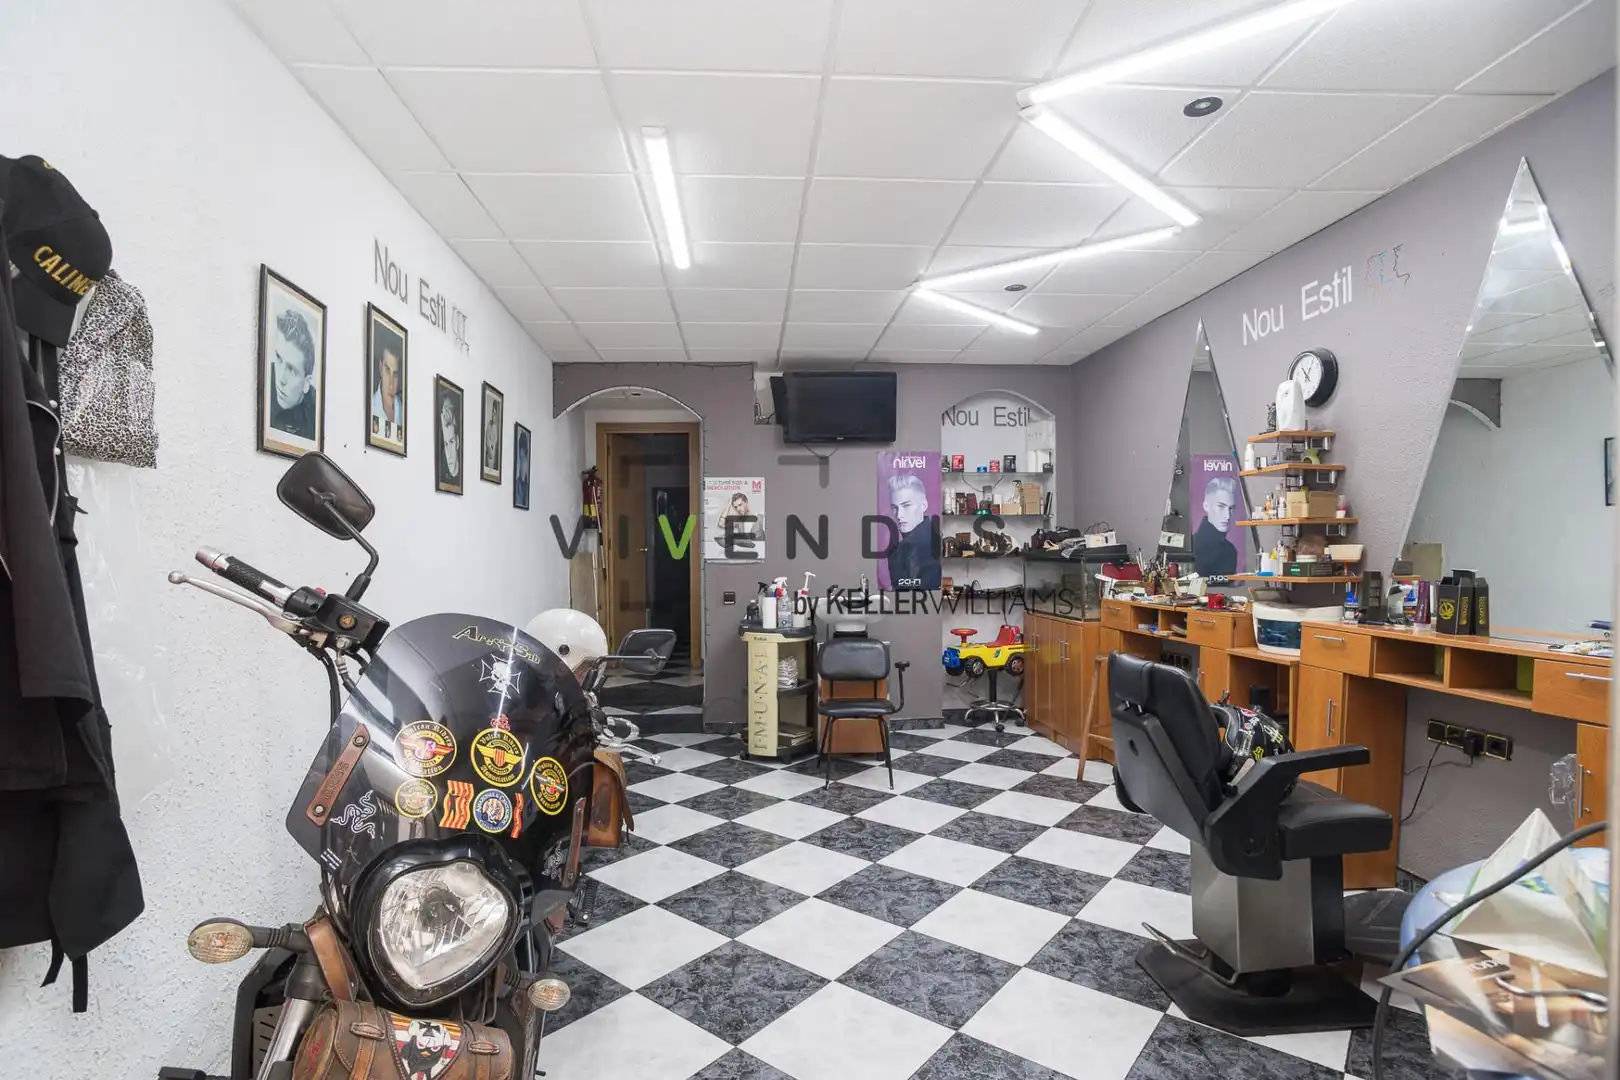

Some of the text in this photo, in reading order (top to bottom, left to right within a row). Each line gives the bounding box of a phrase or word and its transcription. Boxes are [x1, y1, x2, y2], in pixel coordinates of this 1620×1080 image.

[374, 238, 446, 333] Nou Estil
[1241, 265, 1353, 346] Nou Estil
[941, 405, 1031, 428] Nou Estil
[893, 456, 926, 469] nirvel
